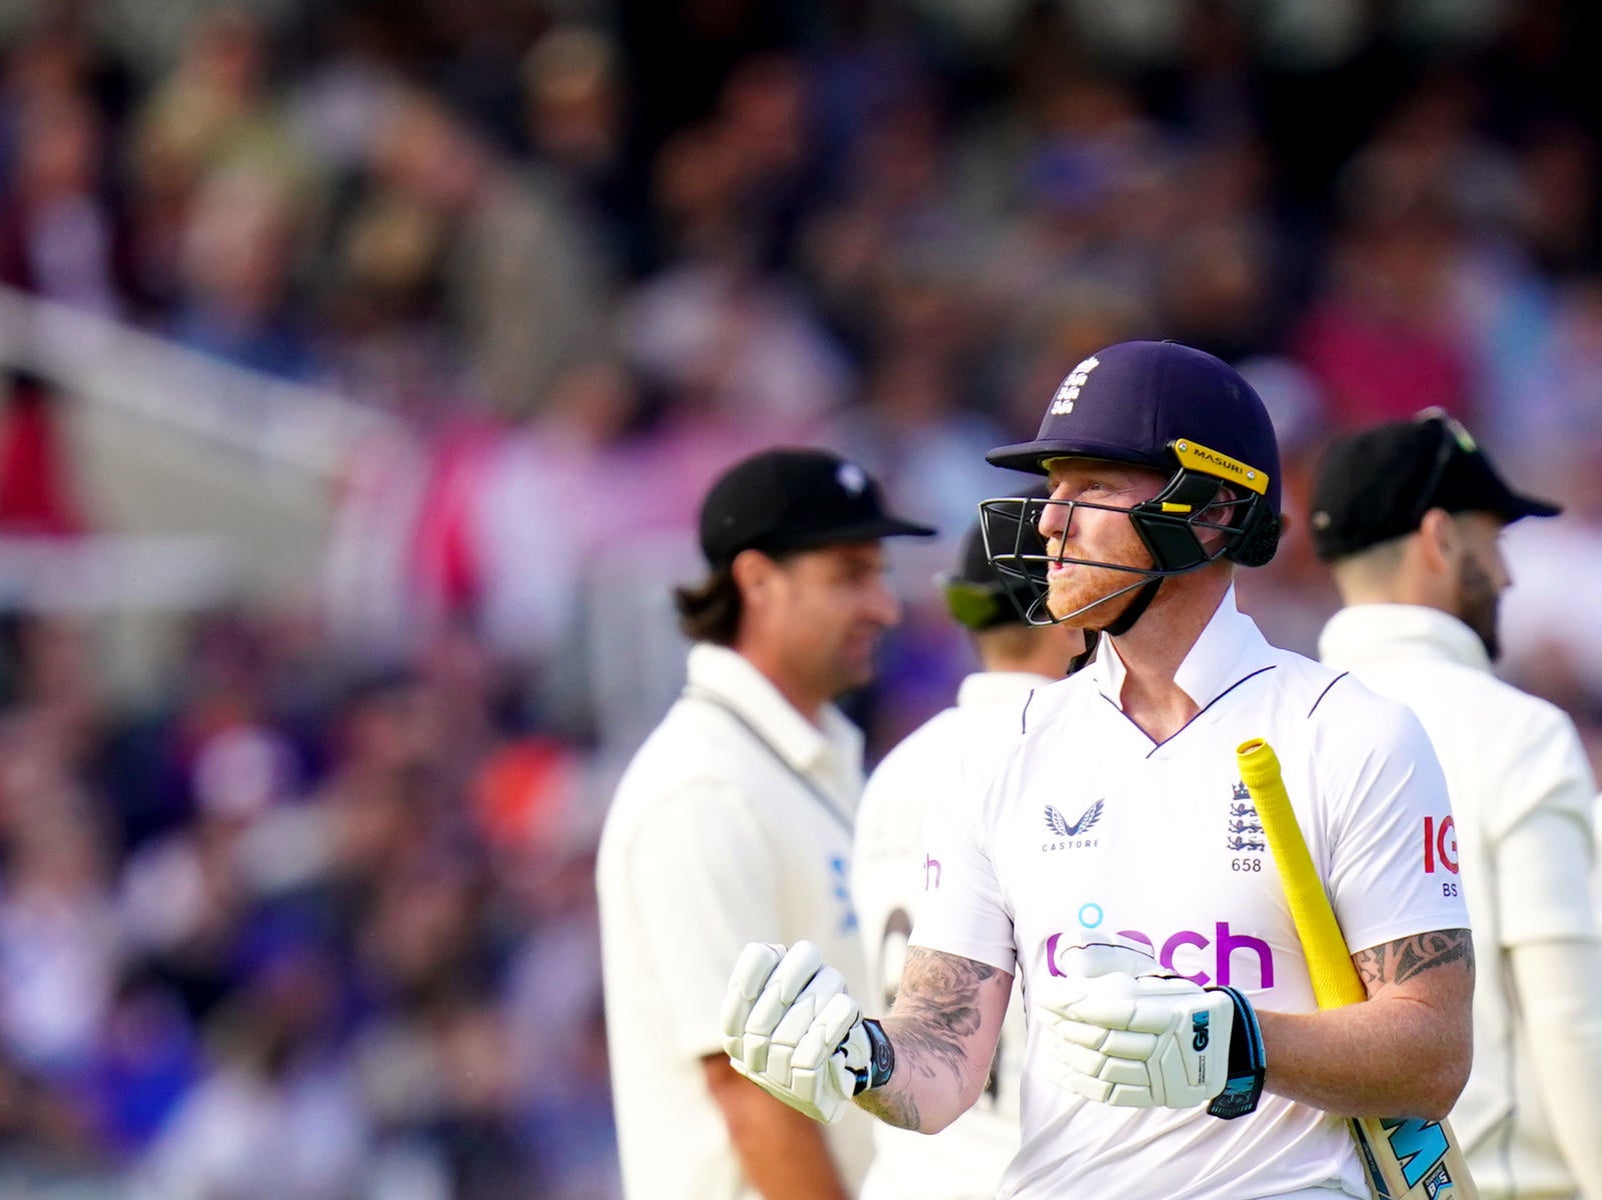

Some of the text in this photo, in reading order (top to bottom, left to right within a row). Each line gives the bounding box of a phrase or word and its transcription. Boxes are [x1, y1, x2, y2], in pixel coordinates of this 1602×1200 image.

[1193, 448, 1244, 474] MASURI
[1041, 838, 1099, 853] CASTORE
[1231, 858, 1262, 873] 658
[1442, 882, 1458, 898] BS
